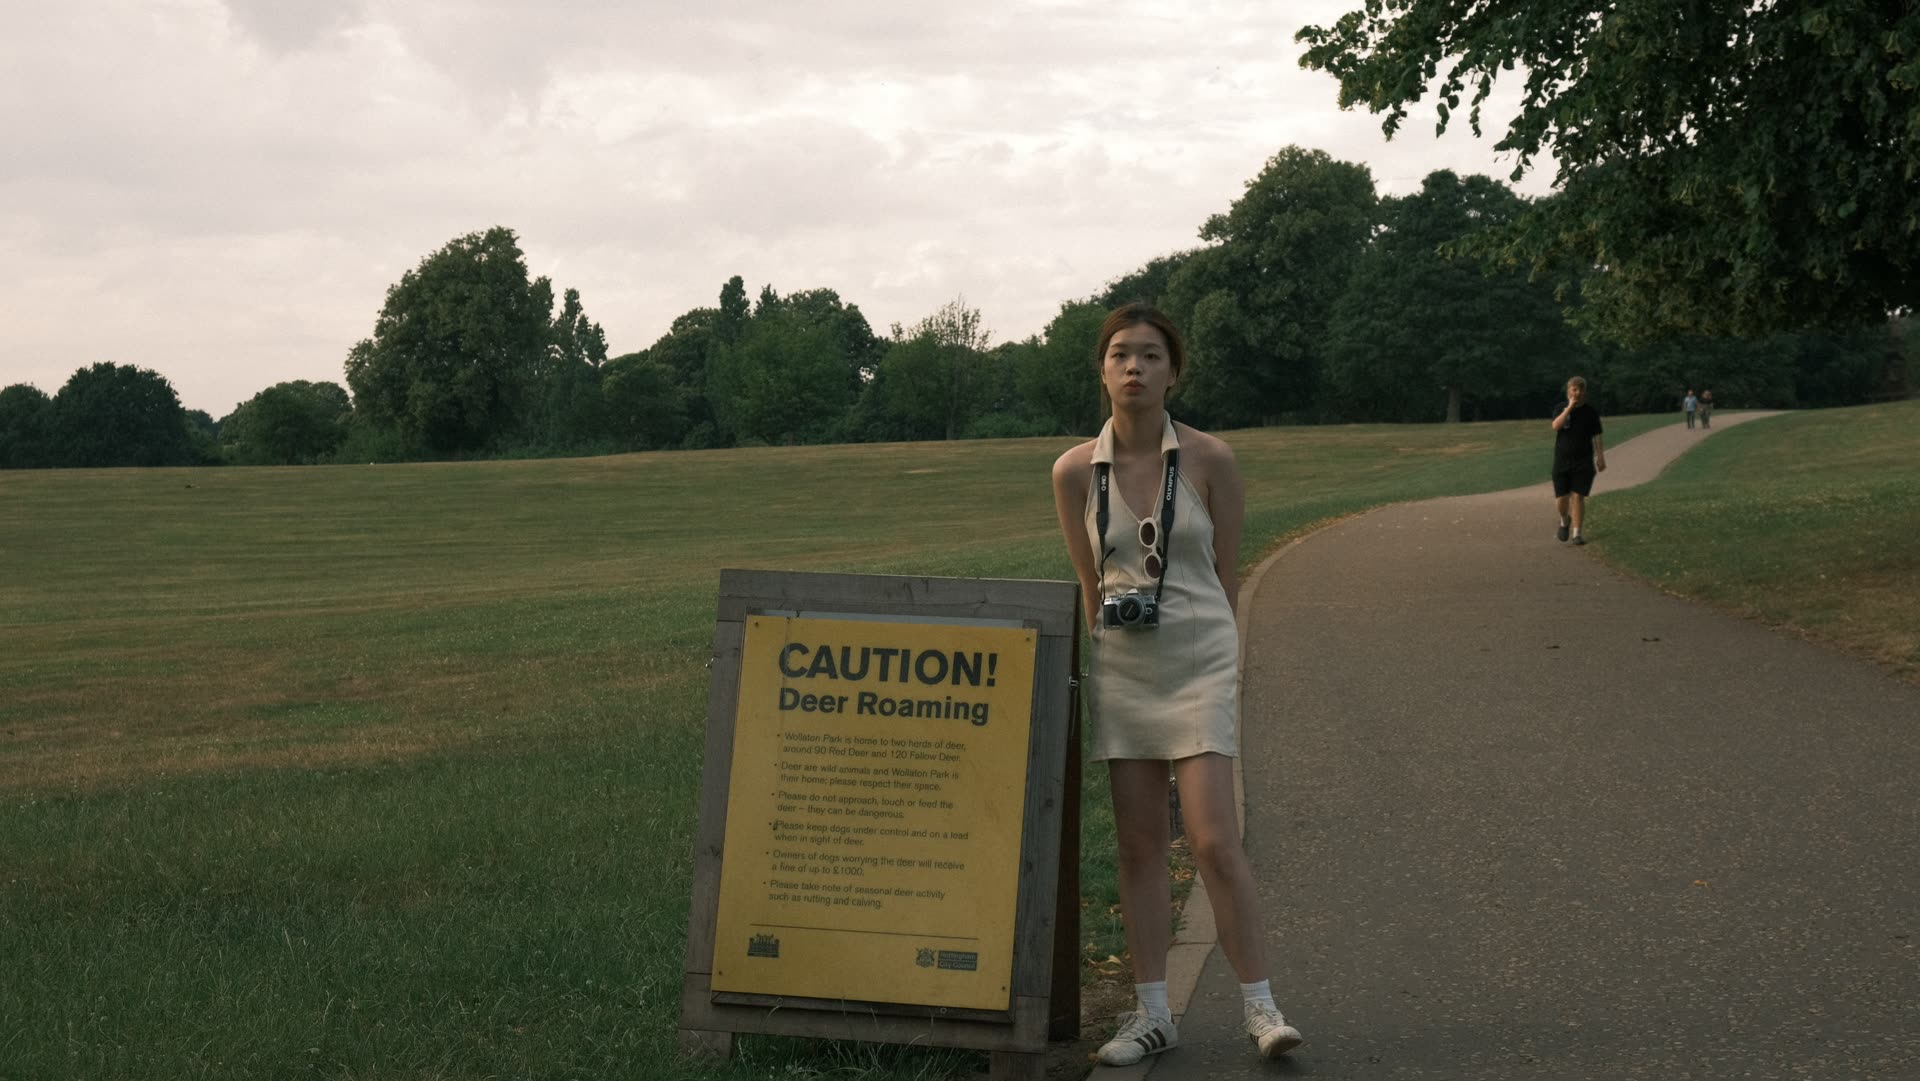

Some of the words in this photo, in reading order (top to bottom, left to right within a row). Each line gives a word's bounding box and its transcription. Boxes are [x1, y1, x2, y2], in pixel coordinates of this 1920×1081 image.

[1166, 466, 1174, 501] OLYMPUS
[779, 642, 998, 687] CAUTION!
[779, 687, 848, 713] Deer
[857, 691, 989, 726] Roaming
[784, 732, 820, 742] Wollaton
[823, 734, 842, 743] Park
[845, 736, 851, 744] is
[854, 737, 878, 746] home
[880, 738, 888, 746] to
[891, 739, 906, 747] two
[908, 740, 932, 748] herds
[934, 740, 944, 749] of
[945, 741, 966, 751] deer,
[783, 746, 812, 754] around
[815, 746, 826, 755] 90
[829, 747, 845, 756] Red
[848, 748, 868, 757] Deer
[871, 750, 886, 758] and
[891, 751, 907, 759] 120
[910, 751, 936, 760] Fallow
[939, 753, 960, 761] Deer.
[781, 762, 801, 770] Deer
[804, 764, 818, 772] are
[820, 764, 836, 773] wild
[839, 765, 870, 775] animals
[873, 767, 888, 776] and
[892, 768, 927, 777] Wollaton
[930, 770, 949, 779] Park
[781, 774, 798, 782] their
[801, 775, 828, 784] home;
[830, 777, 857, 786] please
[860, 778, 891, 789] respect
[894, 781, 911, 789] their
[914, 783, 941, 792] space.
[778, 791, 807, 800] Please
[809, 793, 820, 801] do
[822, 794, 837, 802] not
[839, 796, 879, 805] approach,
[881, 797, 904, 806] touch
[907, 799, 916, 807] or
[918, 799, 937, 808] feed
[940, 800, 953, 809] the
[777, 804, 796, 812] deer
[807, 805, 825, 815] they
[845, 808, 856, 816] be
[859, 809, 904, 819] dangerous.
[777, 821, 803, 830] Please
[807, 823, 827, 833] keep
[830, 825, 850, 834] dogs
[854, 826, 877, 835] under
[880, 828, 909, 836] control
[911, 829, 927, 838] and
[951, 831, 969, 839] lead
[775, 833, 797, 842] when
[800, 834, 807, 842] in
[810, 835, 831, 845] sight
[833, 836, 841, 844] of
[844, 836, 865, 846] deer.
[773, 850, 806, 859] Owners
[808, 852, 817, 860] of
[819, 852, 839, 863] dogs
[843, 855, 878, 866] worrying
[880, 856, 894, 865] the
[896, 858, 915, 867] deer
[918, 859, 932, 868] will
[935, 861, 965, 870] receive
[780, 863, 795, 872] fine
[798, 863, 807, 872] of
[809, 866, 819, 875] up
[833, 867, 865, 876] £1000.
[769, 892, 789, 901] such
[804, 895, 830, 906] rutting
[833, 896, 849, 905] and
[770, 880, 799, 889] Please
[802, 882, 819, 890] take
[822, 883, 841, 892] note
[843, 884, 852, 892] of
[855, 885, 892, 895] seasonal
[894, 888, 913, 896] deer
[916, 889, 945, 900] activity
